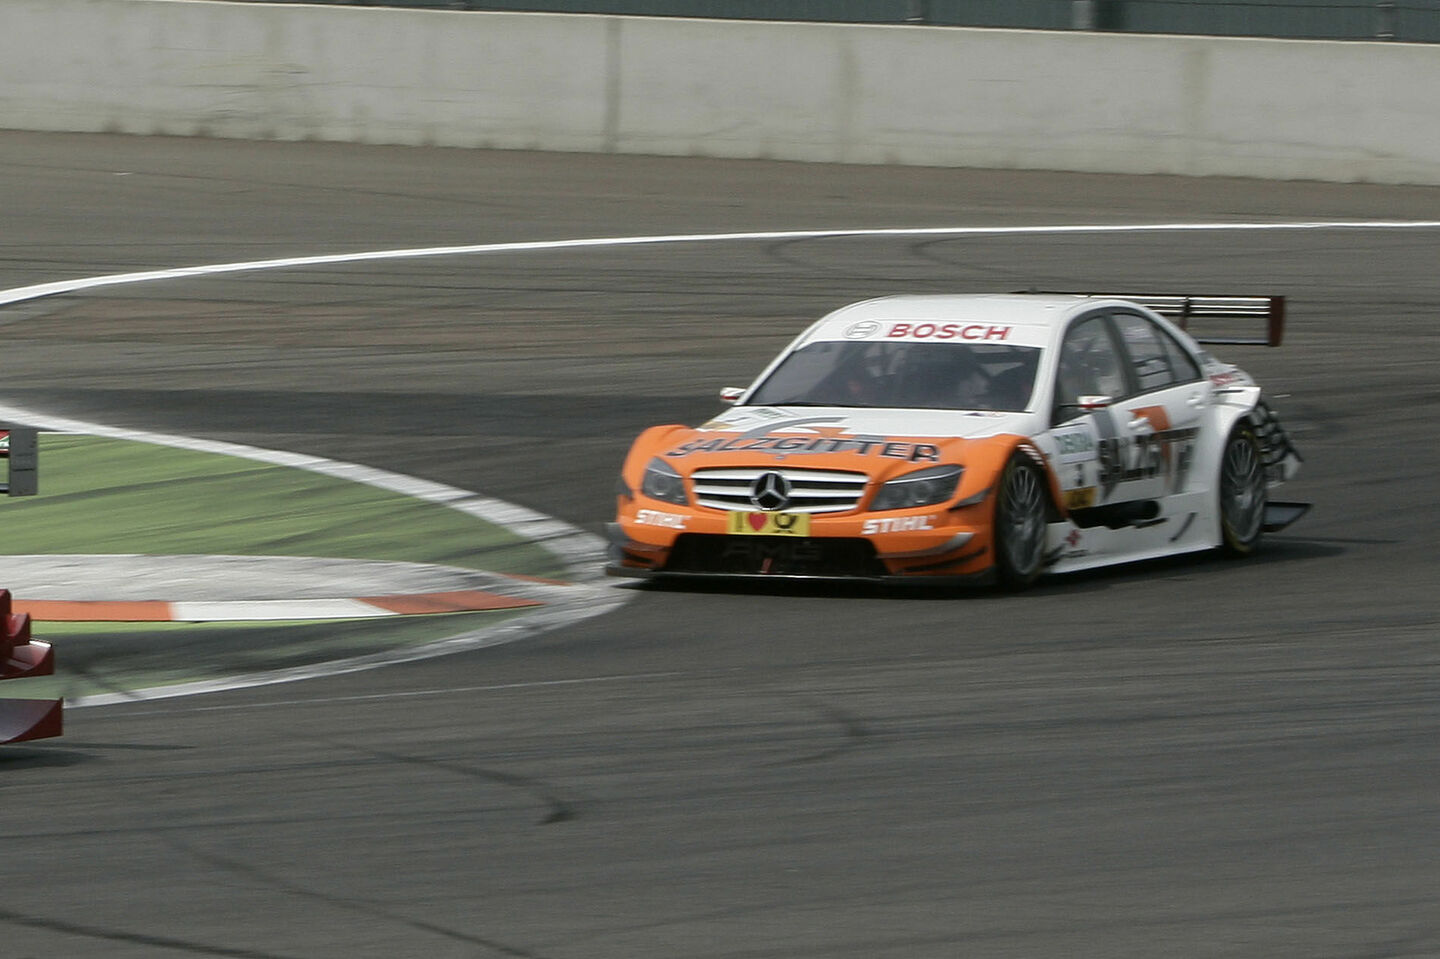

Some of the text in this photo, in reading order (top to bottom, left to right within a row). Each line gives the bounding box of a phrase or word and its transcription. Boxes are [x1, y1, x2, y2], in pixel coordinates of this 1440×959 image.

[885, 323, 1013, 340] BOSCH
[666, 437, 940, 463] SALZGITTER
[634, 508, 693, 530] STIHL
[862, 515, 935, 536] STIHL
